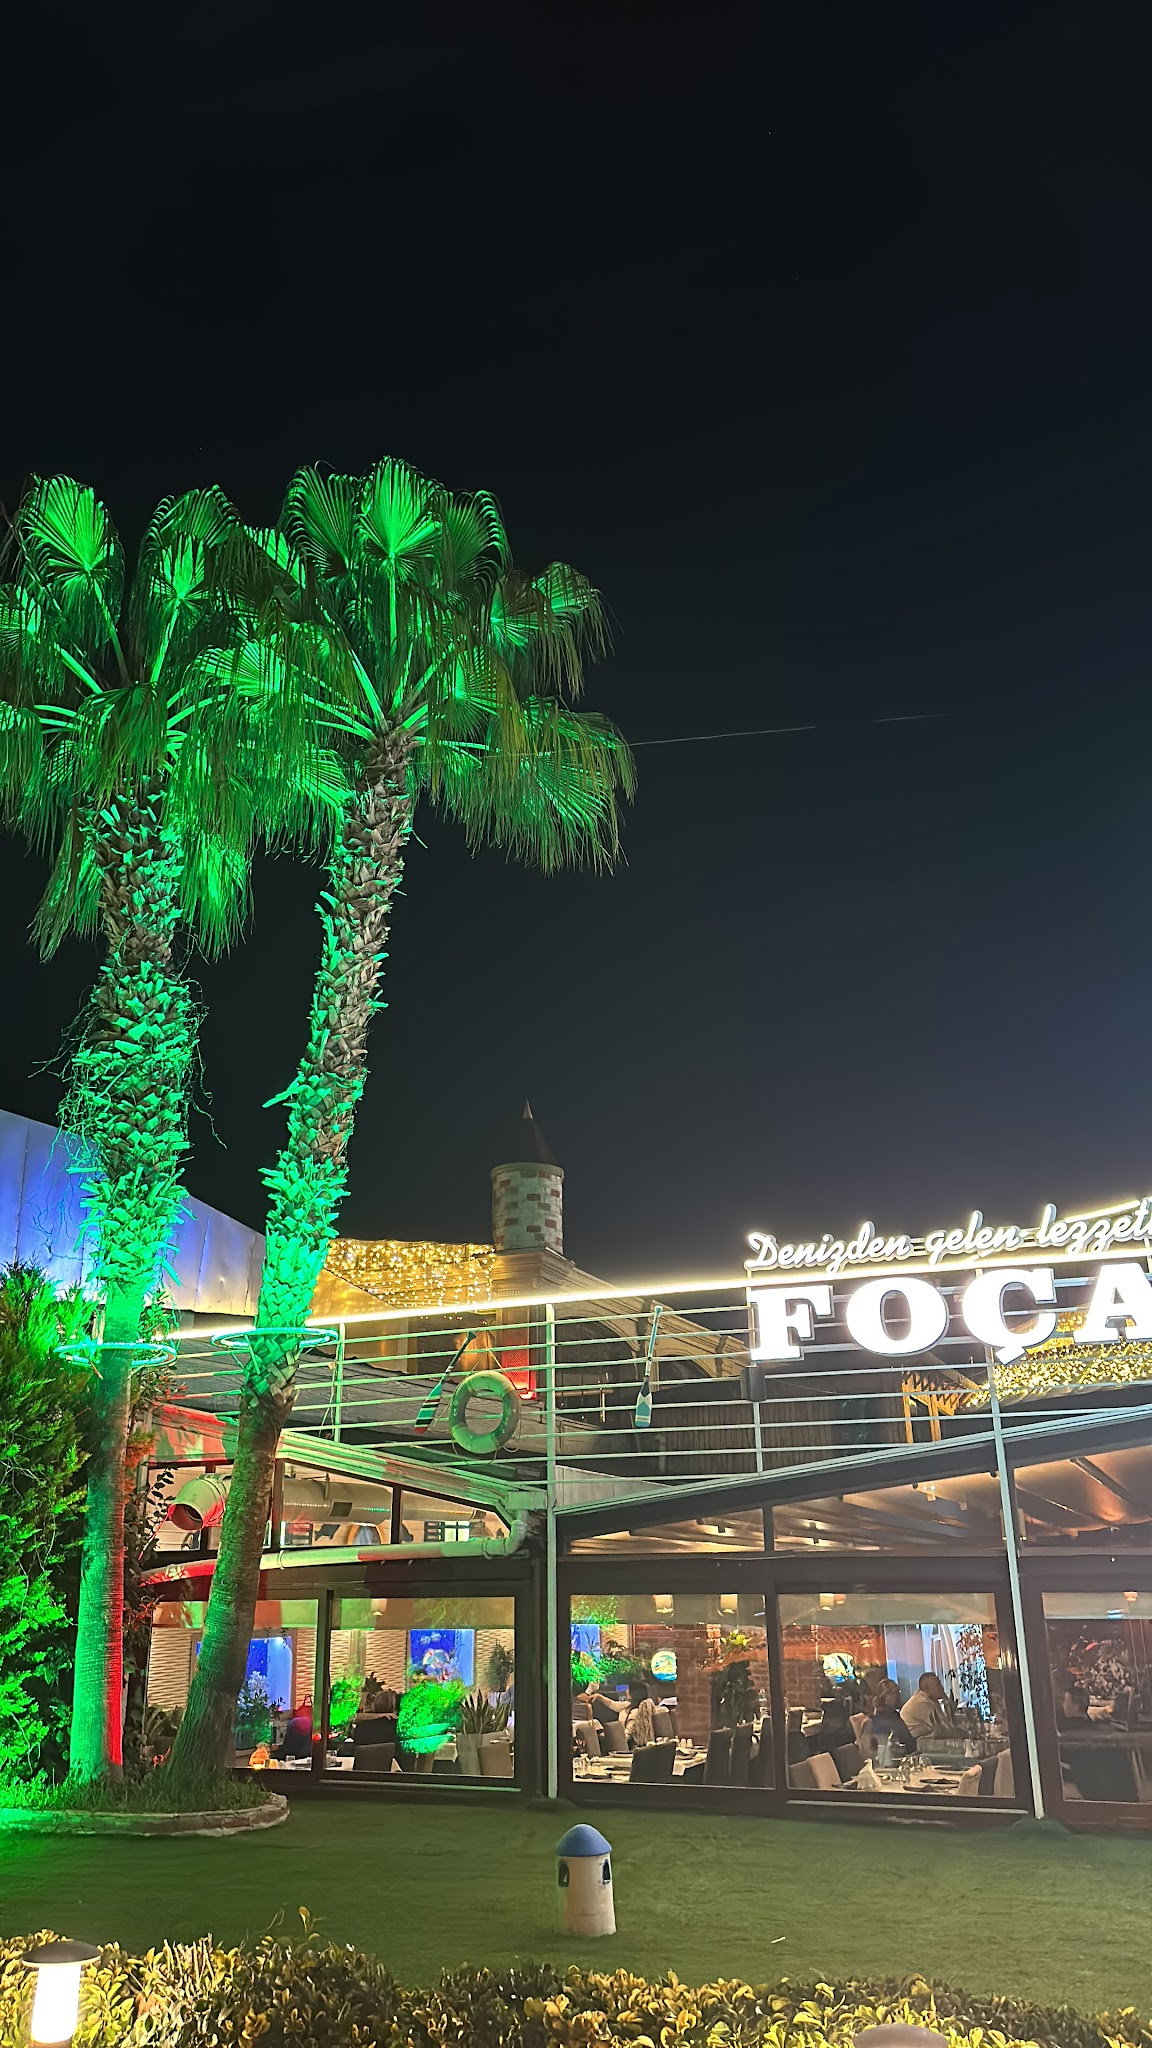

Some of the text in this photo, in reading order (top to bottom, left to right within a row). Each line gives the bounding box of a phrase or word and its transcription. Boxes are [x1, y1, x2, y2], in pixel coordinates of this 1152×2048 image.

[744, 1197, 1152, 1273] Denizden gelen lezzet
[746, 1262, 1152, 1365] FOÇA
